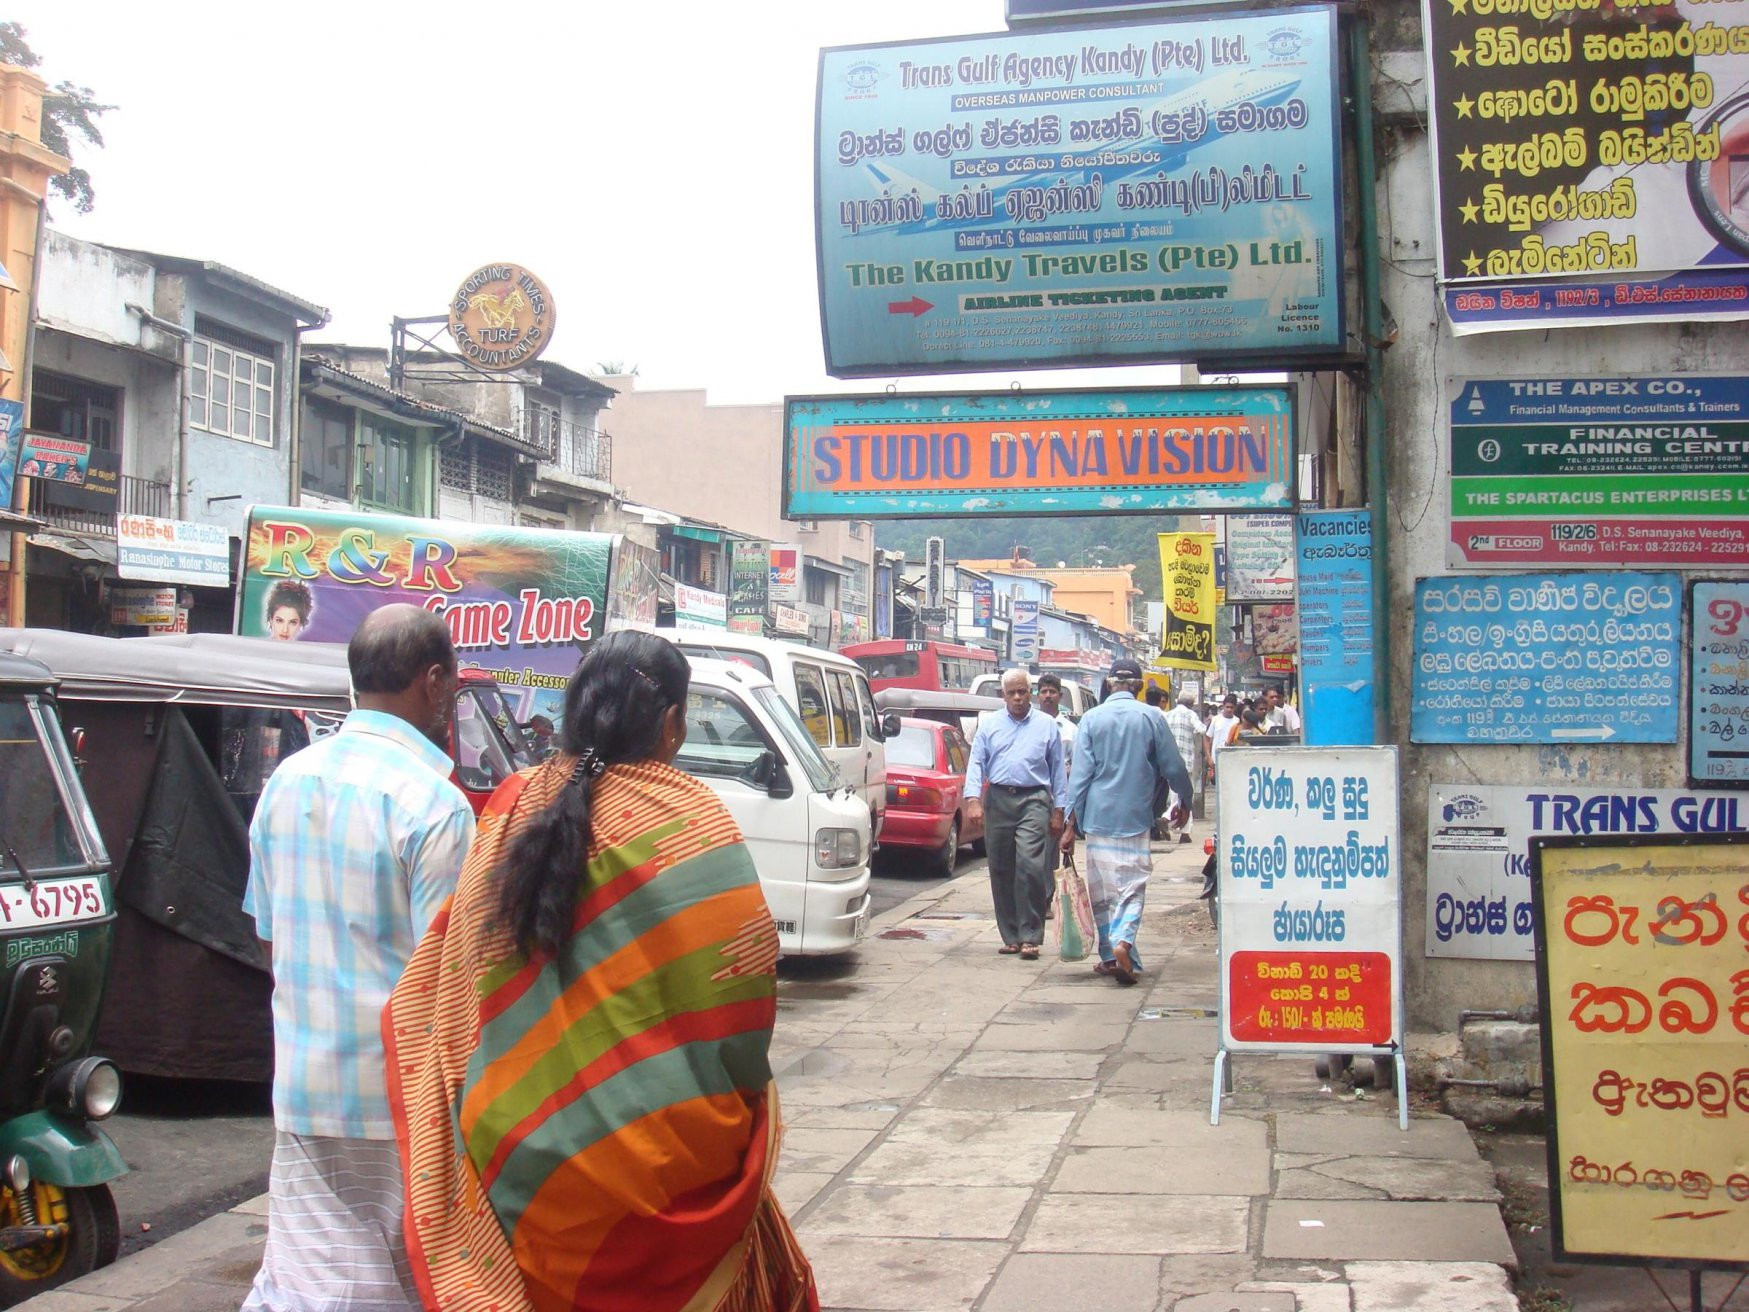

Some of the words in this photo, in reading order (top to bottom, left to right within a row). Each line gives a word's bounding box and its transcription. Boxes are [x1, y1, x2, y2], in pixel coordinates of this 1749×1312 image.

[900, 61, 952, 88] Trans
[958, 54, 1000, 82] Gulf
[1003, 52, 1076, 87] Agency
[1081, 43, 1144, 77] Kandy
[1152, 38, 1204, 76] (Pte)
[1211, 35, 1250, 65] Ltd.
[955, 94, 1015, 108] OVERSEAS
[1019, 90, 1085, 106] MANPOWER
[1089, 83, 1164, 98] CONSULTANT
[1216, 98, 1309, 133] සමාගම
[846, 263, 905, 287] The
[914, 256, 1012, 284] Kandy
[1021, 249, 1149, 277] Travels
[1158, 244, 1239, 273] (Pte)
[1250, 240, 1312, 266] Ltd.
[455, 266, 512, 312] SPORTING
[516, 272, 545, 315] TIMES
[964, 295, 1043, 311] AIRLINE
[1048, 289, 1155, 306] TICKETING
[1161, 285, 1228, 300] AGENT
[1285, 303, 1319, 311] Labour
[1281, 314, 1319, 322] Licence
[1296, 323, 1320, 332] 1310
[454, 324, 541, 364] ACCOUNTANTS
[479, 329, 519, 343] TURF
[1509, 382, 1563, 396] THE
[1572, 381, 1639, 396] APEX
[1647, 380, 1702, 397] CO.,
[1510, 404, 1556, 415] Financial
[1558, 403, 1620, 416] Management
[1624, 402, 1685, 414] Consultants
[1688, 402, 1697, 412] &
[1699, 401, 1740, 412] Trainers
[1569, 427, 1718, 440] FINANCIAL
[814, 432, 971, 482] STUDIO
[1522, 442, 1652, 456] TRAINING
[1466, 493, 1499, 505] THE
[1505, 492, 1604, 504] SPARTACUS
[1611, 489, 1732, 502] ENTERPRISES
[1738, 489, 1749, 500] L
[1603, 527, 1625, 537] D.S.
[1628, 526, 1694, 540] Senanayake
[1698, 527, 1745, 541] Veediya,
[1470, 535, 1490, 550] 2nd
[1499, 539, 1541, 548] FLOOR
[121, 550, 175, 568] Ranasinghe
[179, 556, 203, 569] Motor
[205, 560, 229, 572] Stores
[260, 520, 318, 578] R
[328, 527, 396, 587] &
[401, 534, 462, 592] R
[735, 572, 764, 580] INTERNET
[517, 588, 593, 643] Zone
[1301, 657, 1322, 665] Drivers
[1526, 795, 1659, 834] TRANS
[1309, 964, 1328, 979] 20
[1319, 986, 1329, 1000] 4
